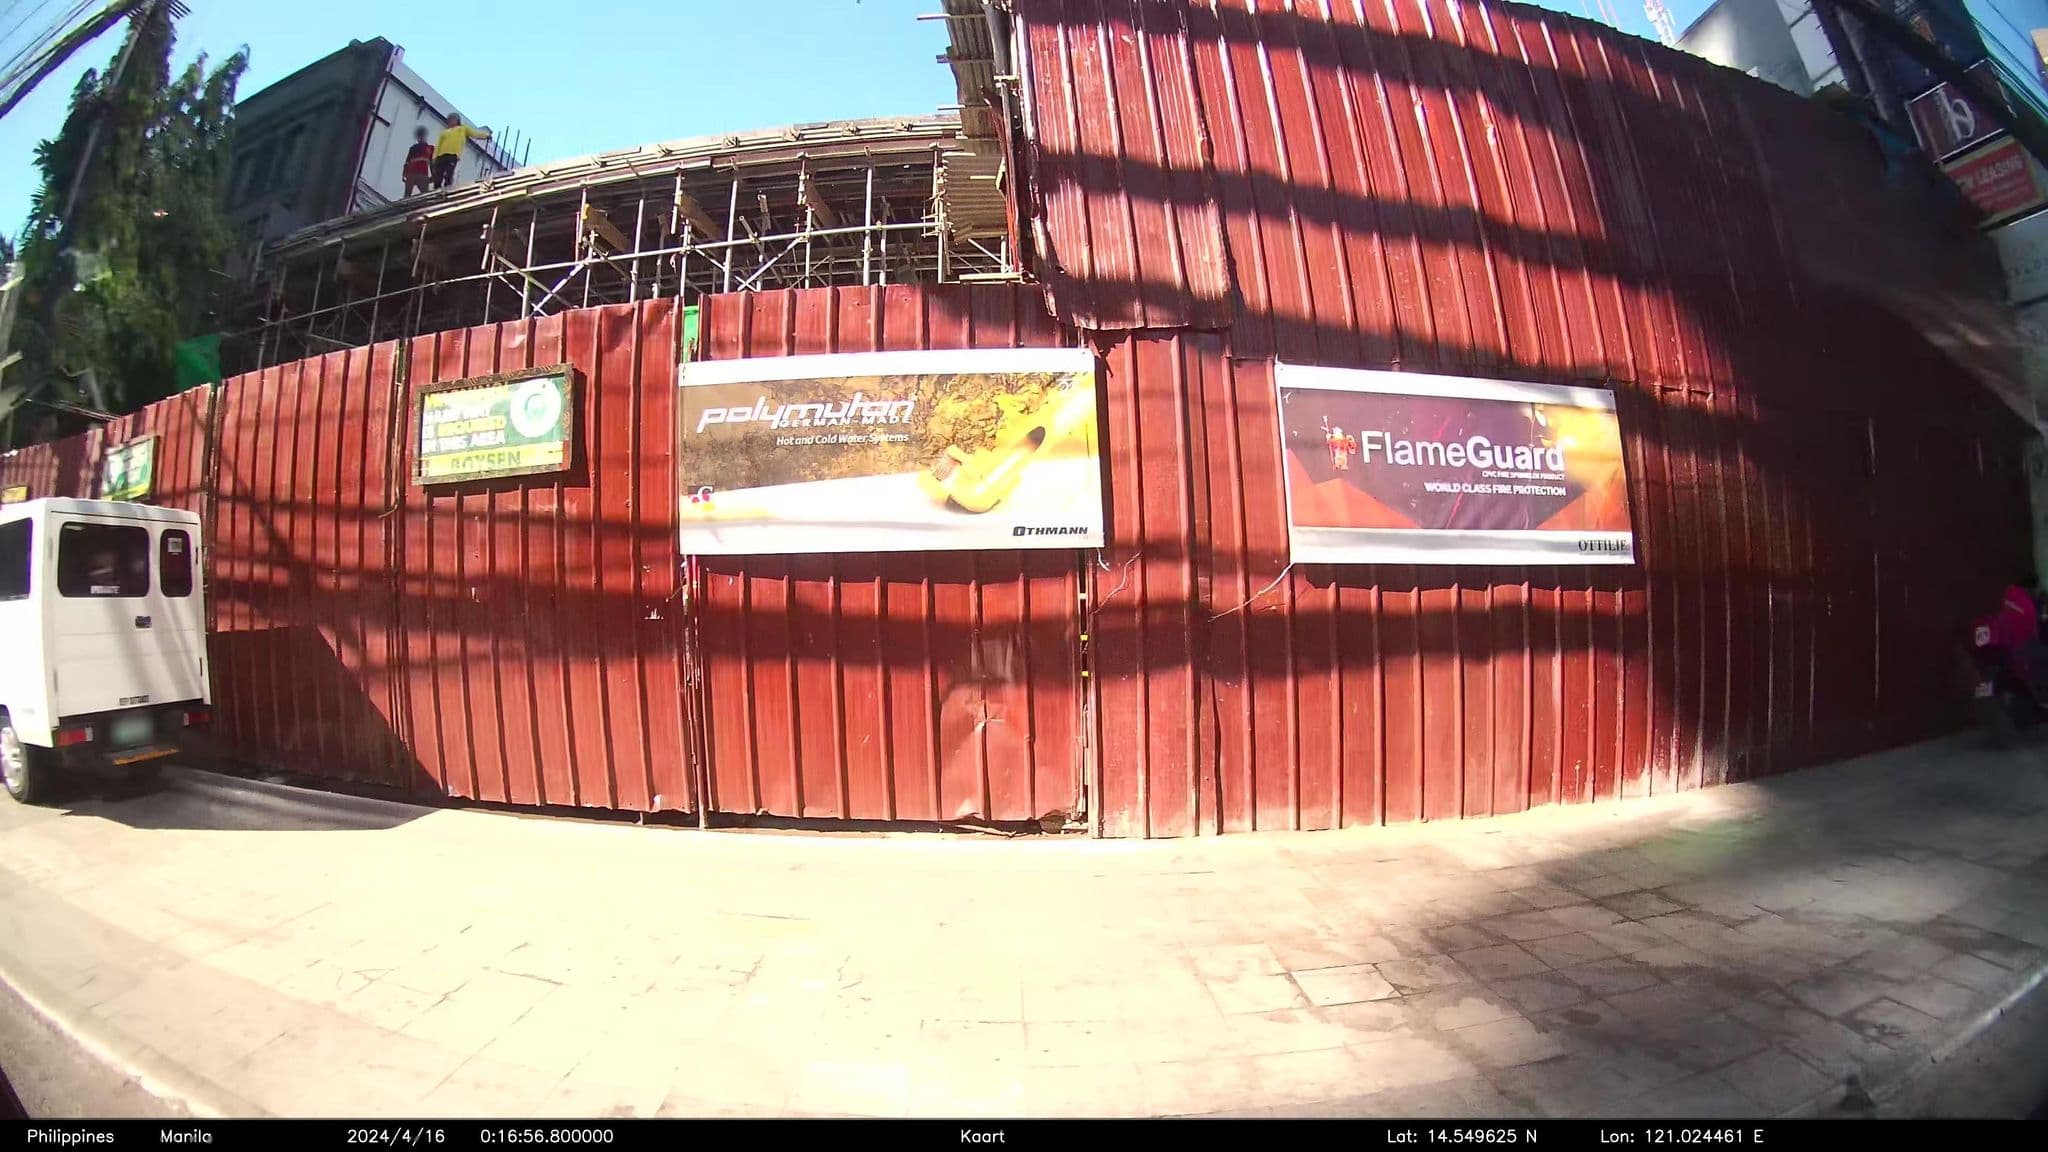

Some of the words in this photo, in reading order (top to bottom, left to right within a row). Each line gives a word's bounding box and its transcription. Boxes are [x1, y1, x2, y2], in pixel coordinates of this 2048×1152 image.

[696, 391, 917, 434] polymutan
[779, 415, 912, 429] GERMAN-MADE
[776, 436, 794, 446] Hot
[795, 436, 814, 445] and
[815, 434, 837, 445] Cold
[838, 434, 867, 444] Water
[868, 433, 909, 445] Systems
[1361, 430, 1565, 471] FlameGuard
[451, 450, 521, 470] BOYSEN
[1424, 482, 1461, 493] WORLD
[1462, 483, 1492, 494] CLASS
[1493, 484, 1512, 495] FIRE
[1513, 485, 1566, 496] PROTECTION
[1012, 526, 1088, 536] OTHMANN
